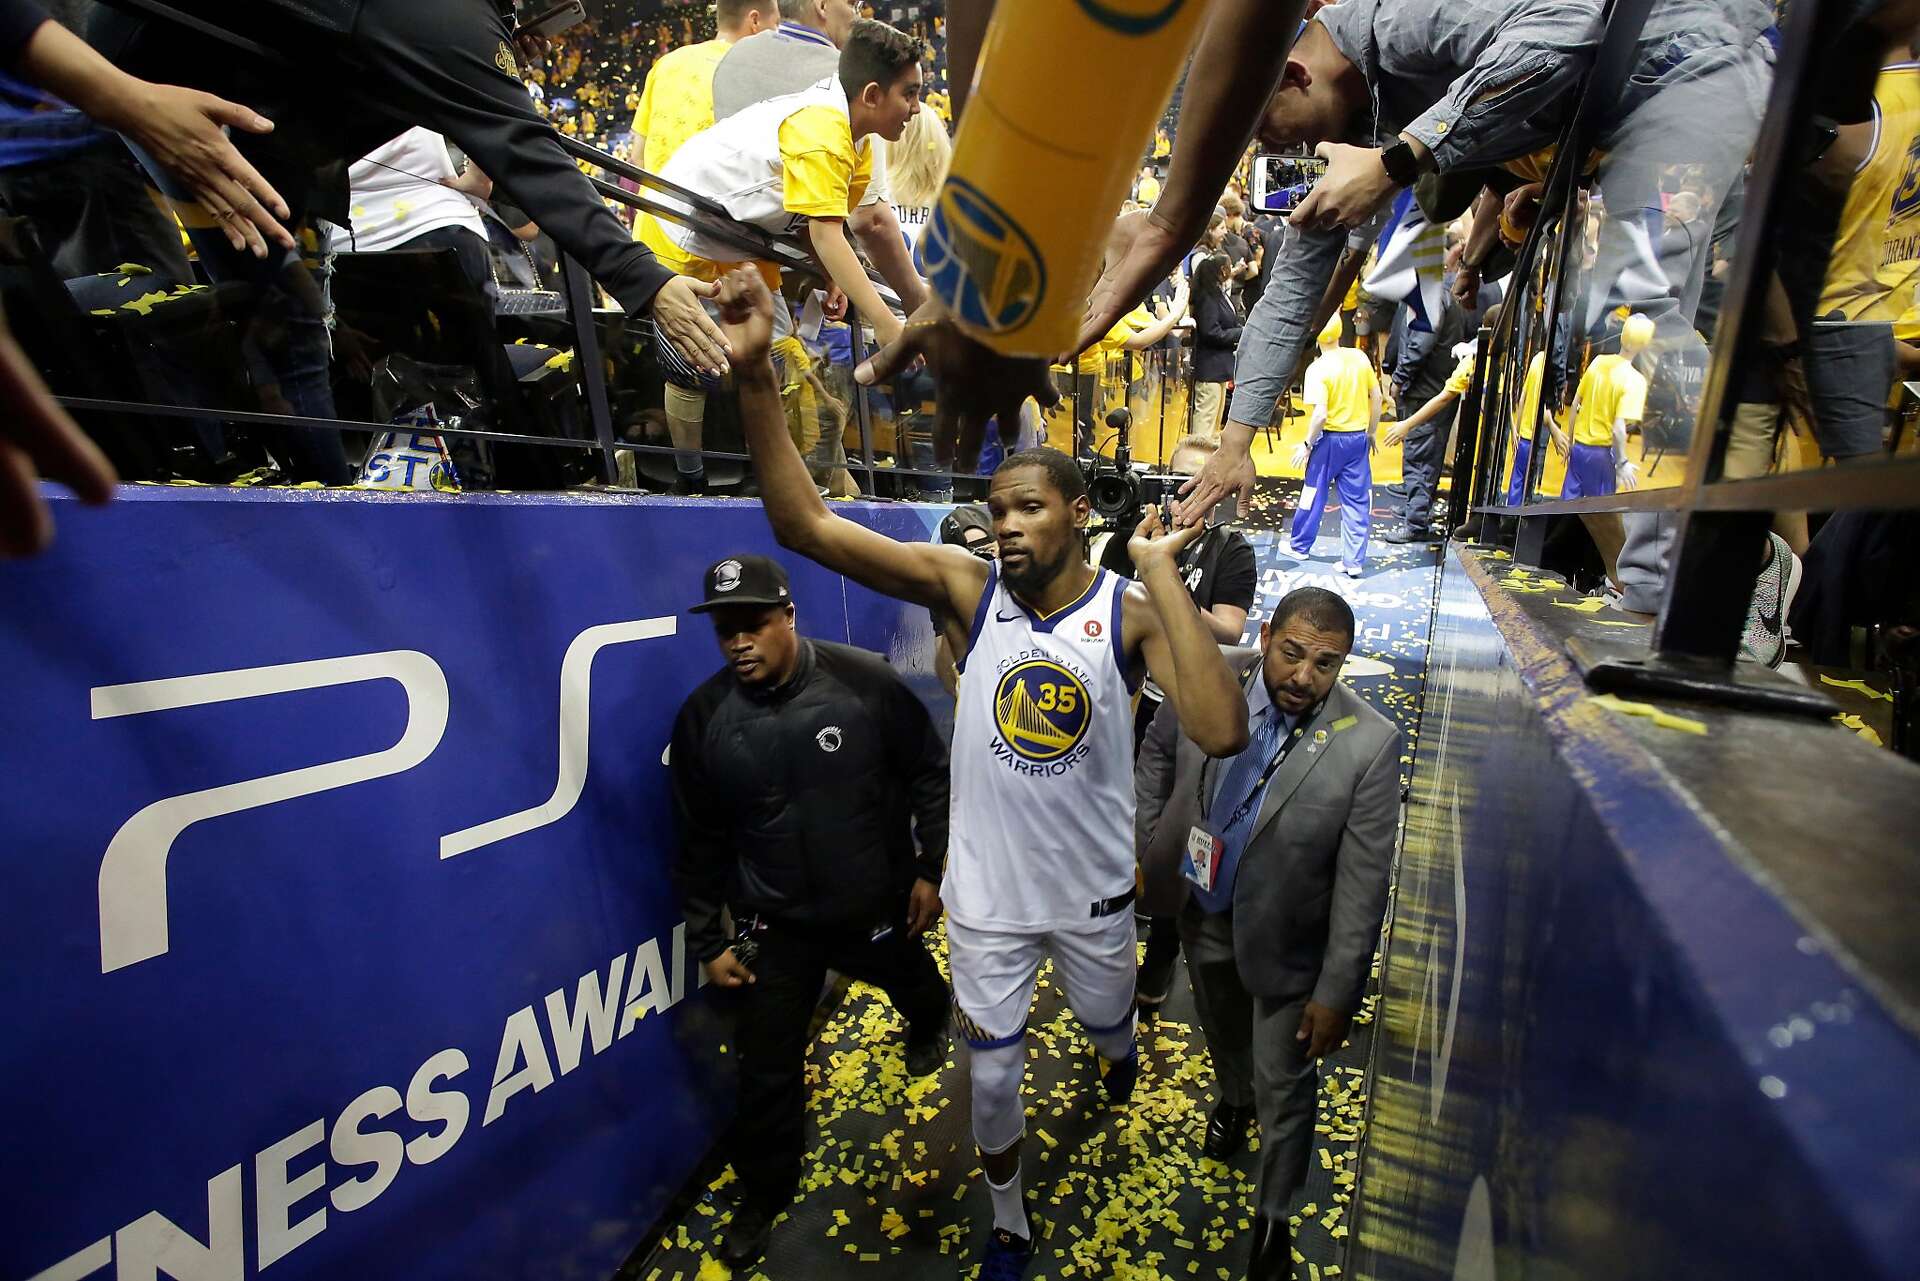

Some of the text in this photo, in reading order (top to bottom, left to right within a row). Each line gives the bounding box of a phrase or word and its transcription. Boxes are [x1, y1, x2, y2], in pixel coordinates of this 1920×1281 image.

[891, 205, 930, 224] URR
[1037, 683, 1077, 714] 35
[989, 736, 1091, 778] WARRIORS
[91, 616, 677, 973] PS
[25, 920, 711, 1281] NESS AWAI
